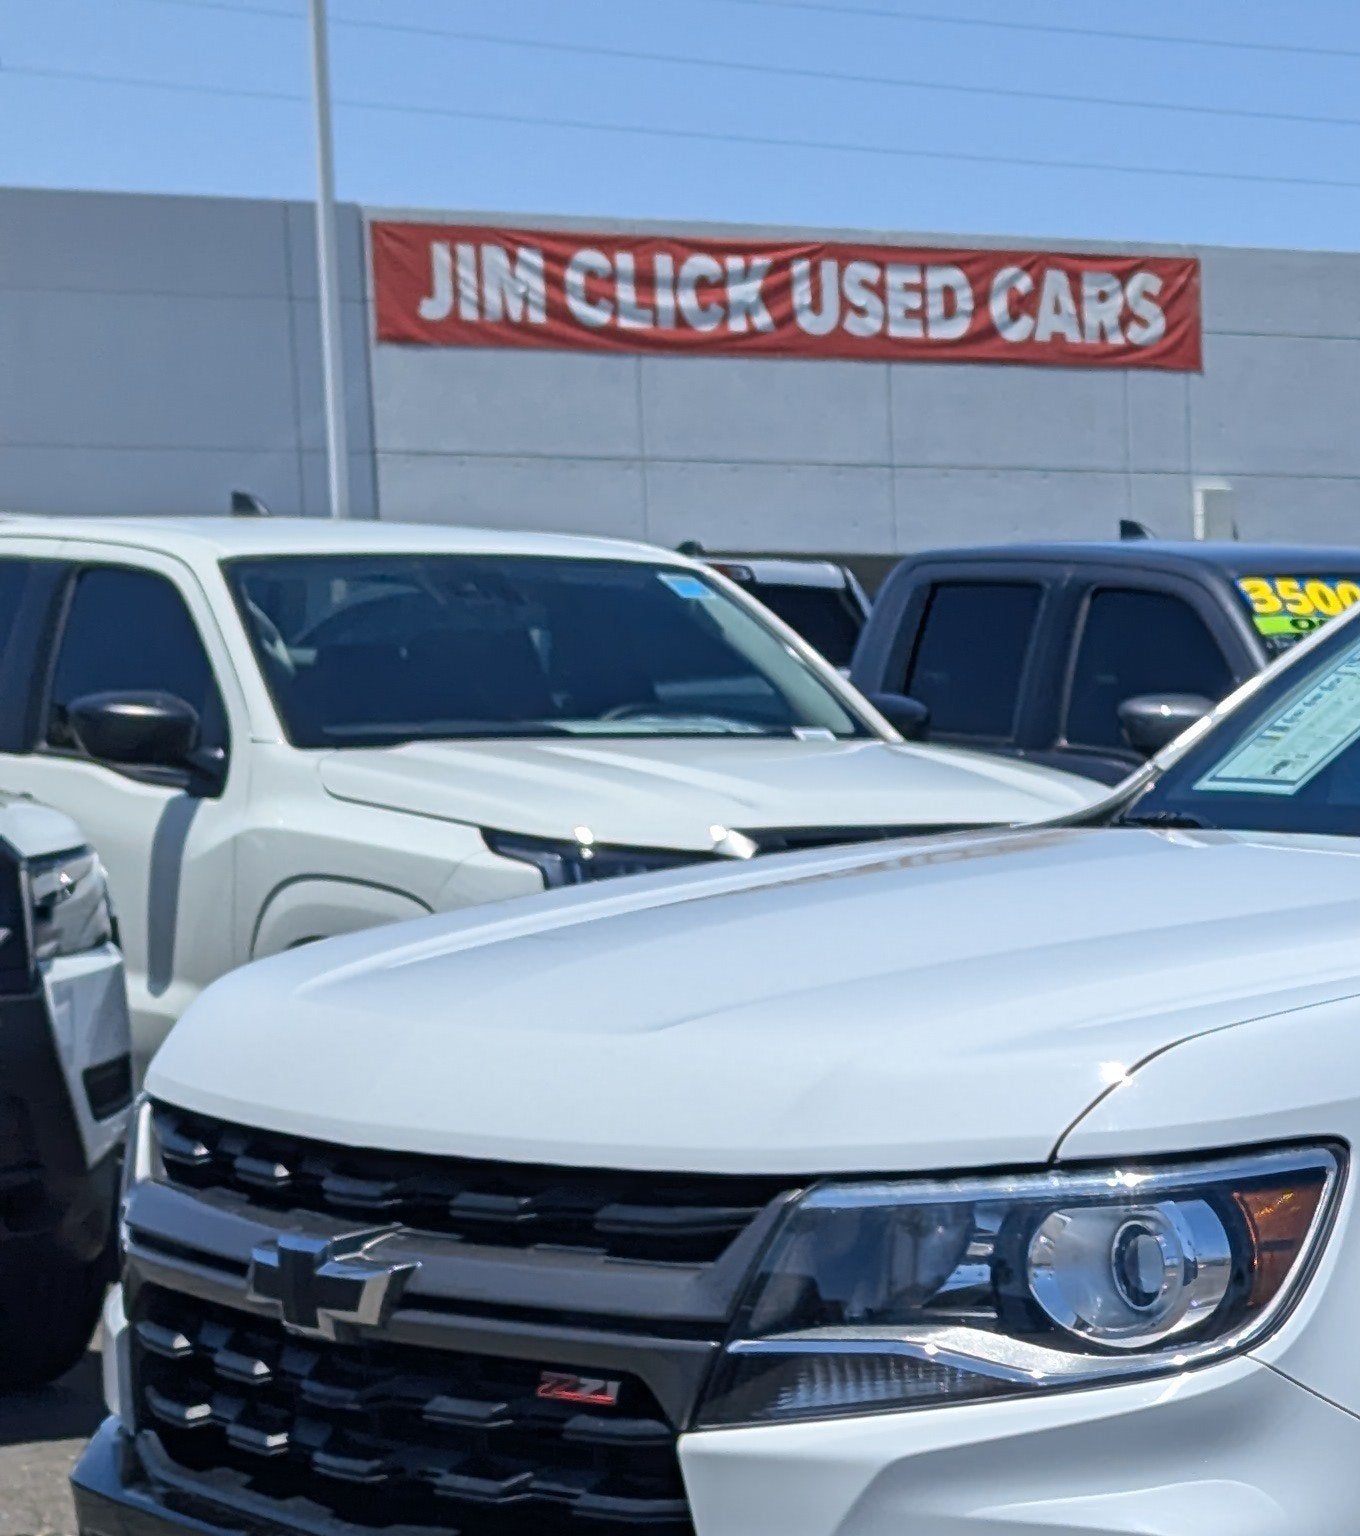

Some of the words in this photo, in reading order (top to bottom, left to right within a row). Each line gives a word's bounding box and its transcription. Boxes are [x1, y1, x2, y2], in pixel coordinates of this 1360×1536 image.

[417, 240, 548, 325] JIM
[563, 247, 778, 334] CLICK
[791, 257, 976, 342] USED
[988, 266, 1167, 346] CARS
[536, 1370, 621, 1407] Z71
